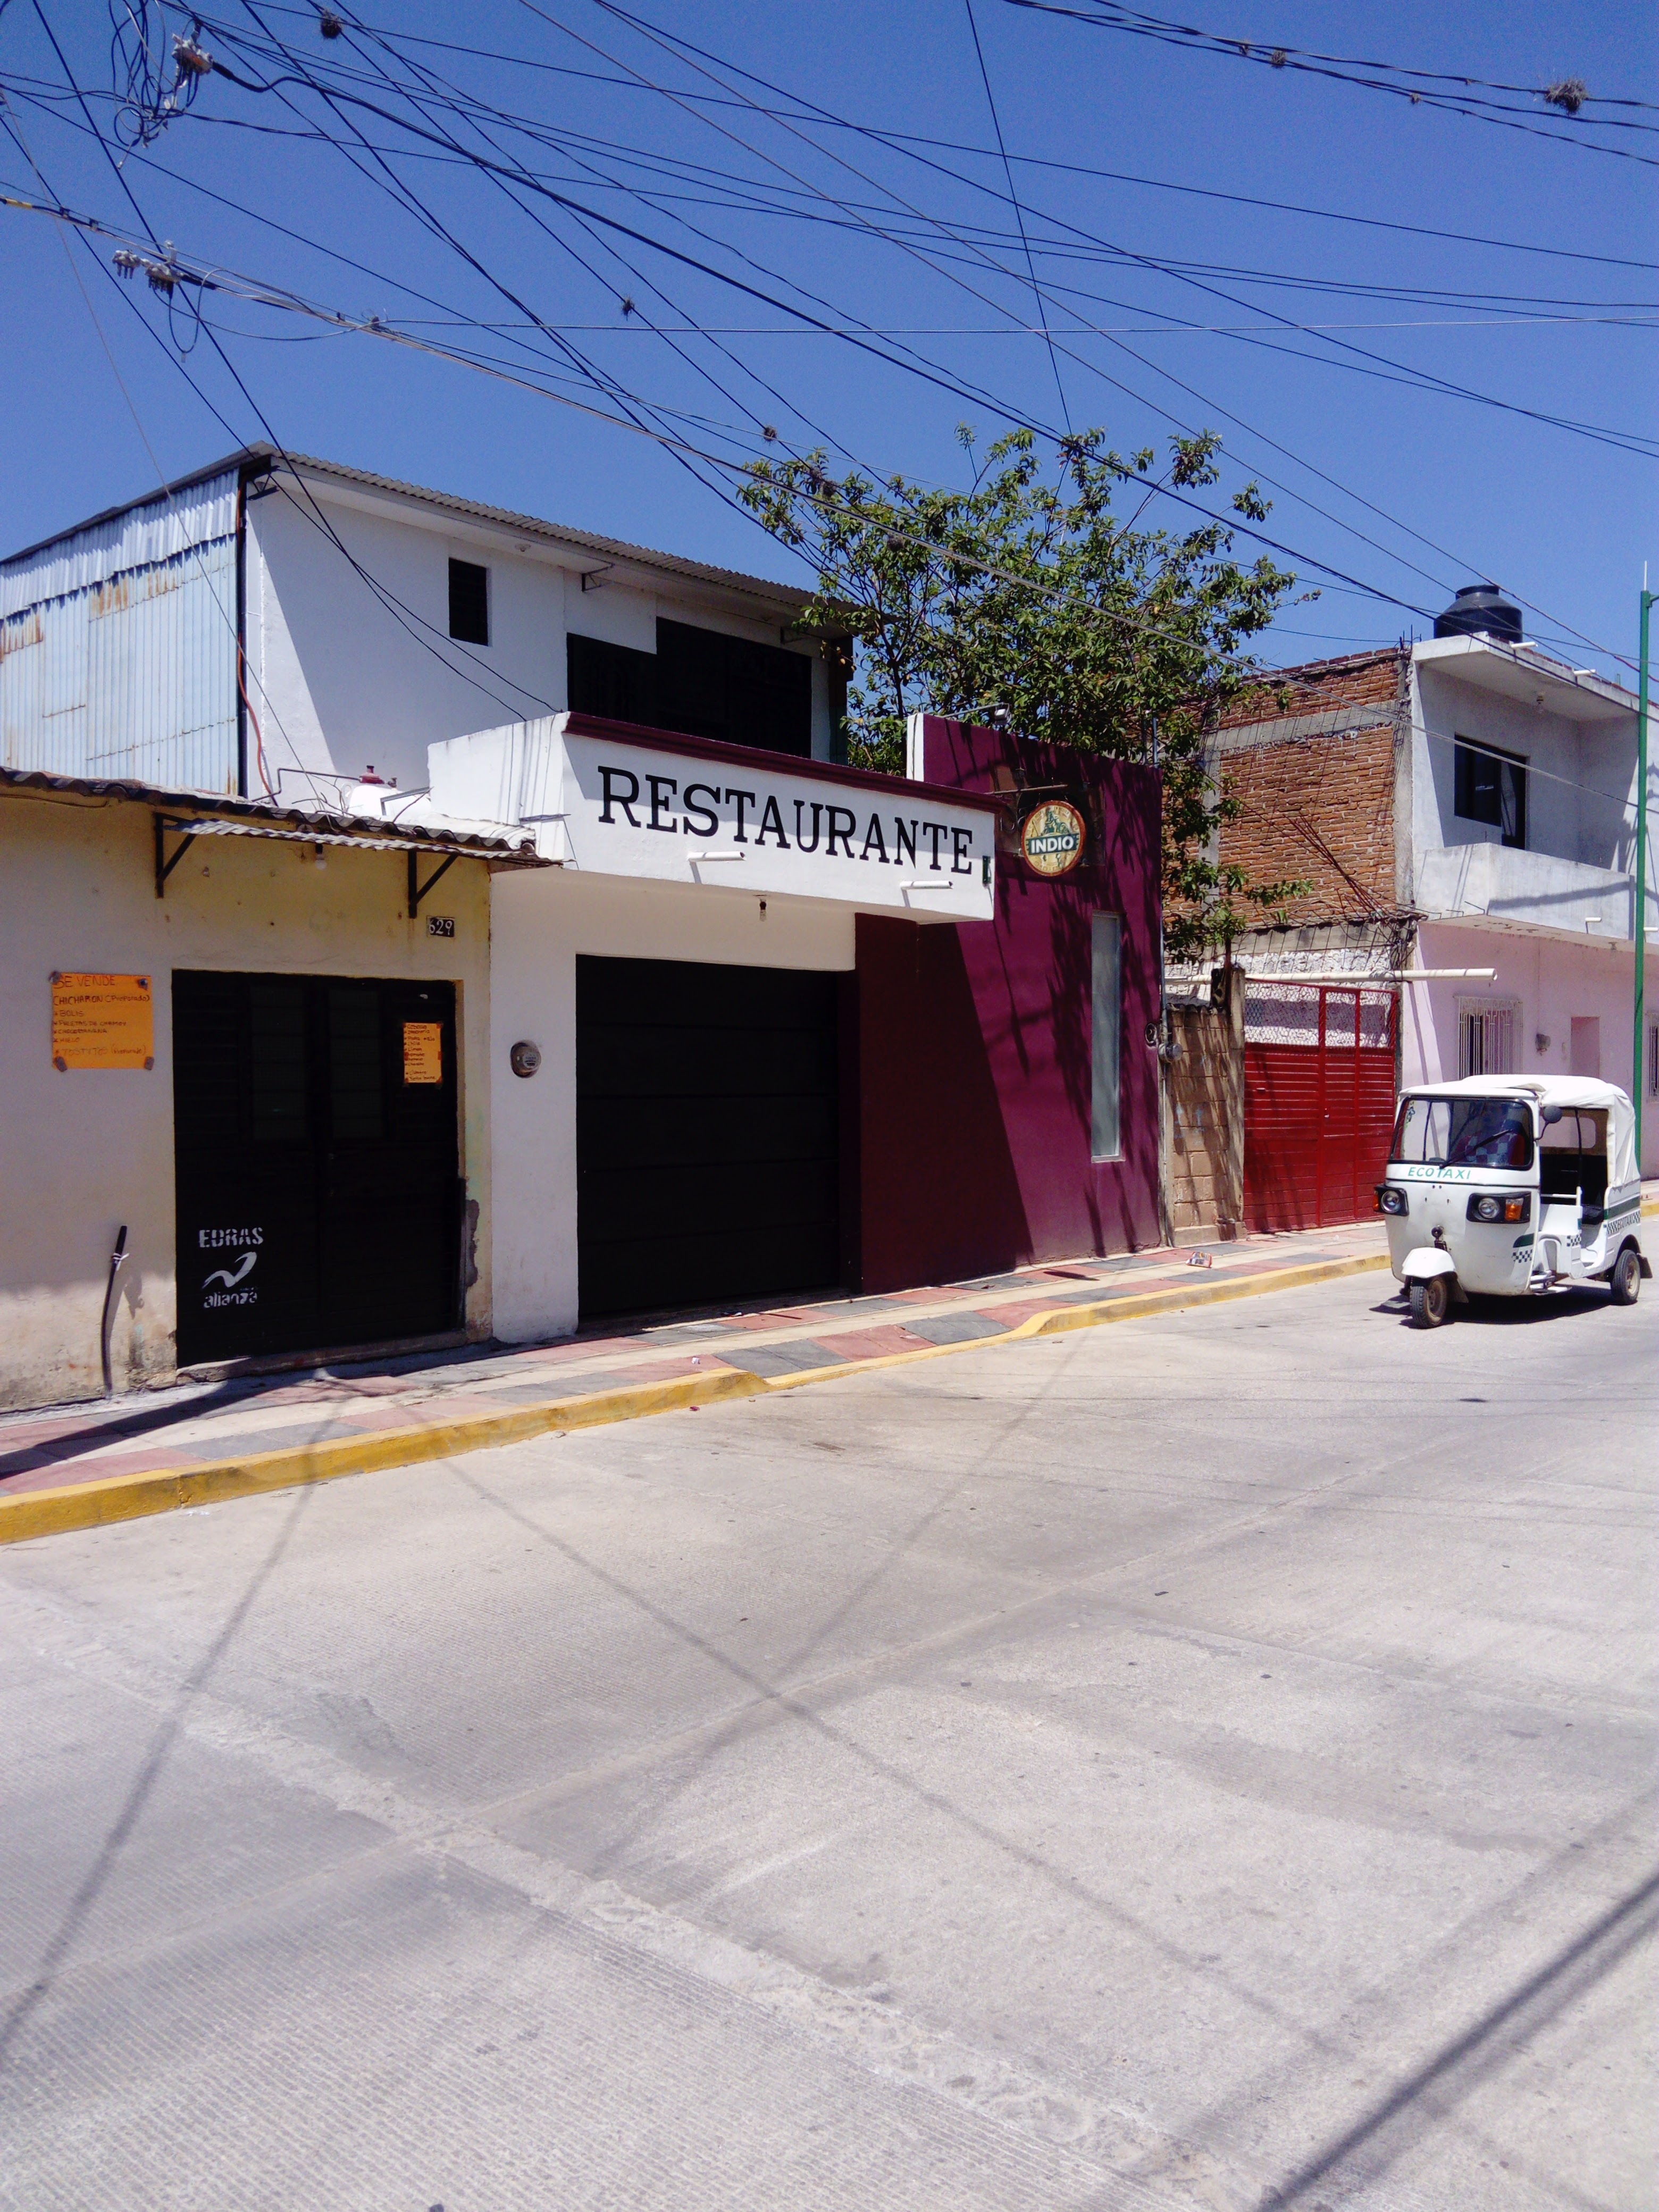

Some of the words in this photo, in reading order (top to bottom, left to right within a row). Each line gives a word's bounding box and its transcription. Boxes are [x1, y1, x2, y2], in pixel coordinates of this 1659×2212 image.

[598, 766, 973, 875] RESTAURANTE
[1030, 836, 1074, 853] INDIO
[429, 919, 453, 935] 629
[77, 975, 115, 987] VENDE
[1407, 1167, 1471, 1180] ECOTAXI
[199, 1227, 264, 1248] EDRAS
